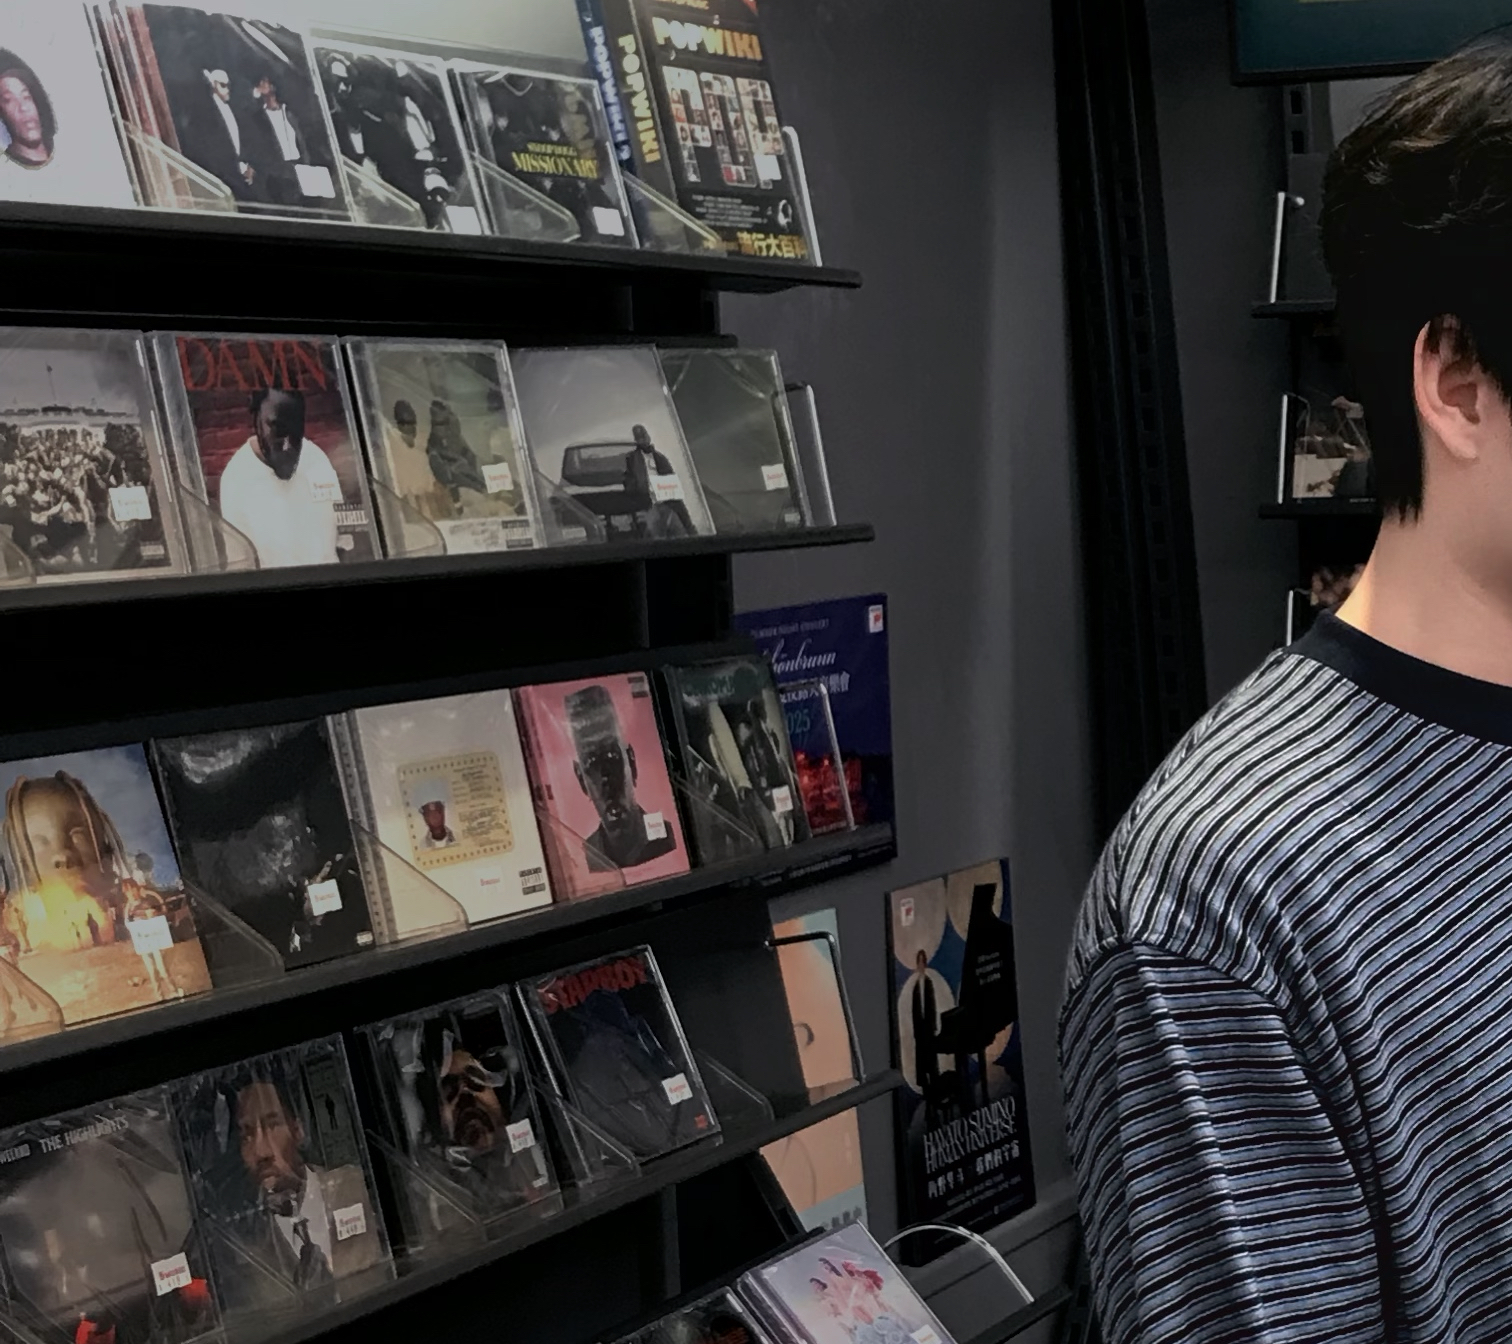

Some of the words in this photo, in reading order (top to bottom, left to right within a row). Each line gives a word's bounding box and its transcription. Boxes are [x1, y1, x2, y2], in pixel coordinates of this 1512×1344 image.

[652, 16, 763, 61] POPWIKI
[618, 34, 661, 163] POPWIKI
[39, 1134, 63, 1153] THE
